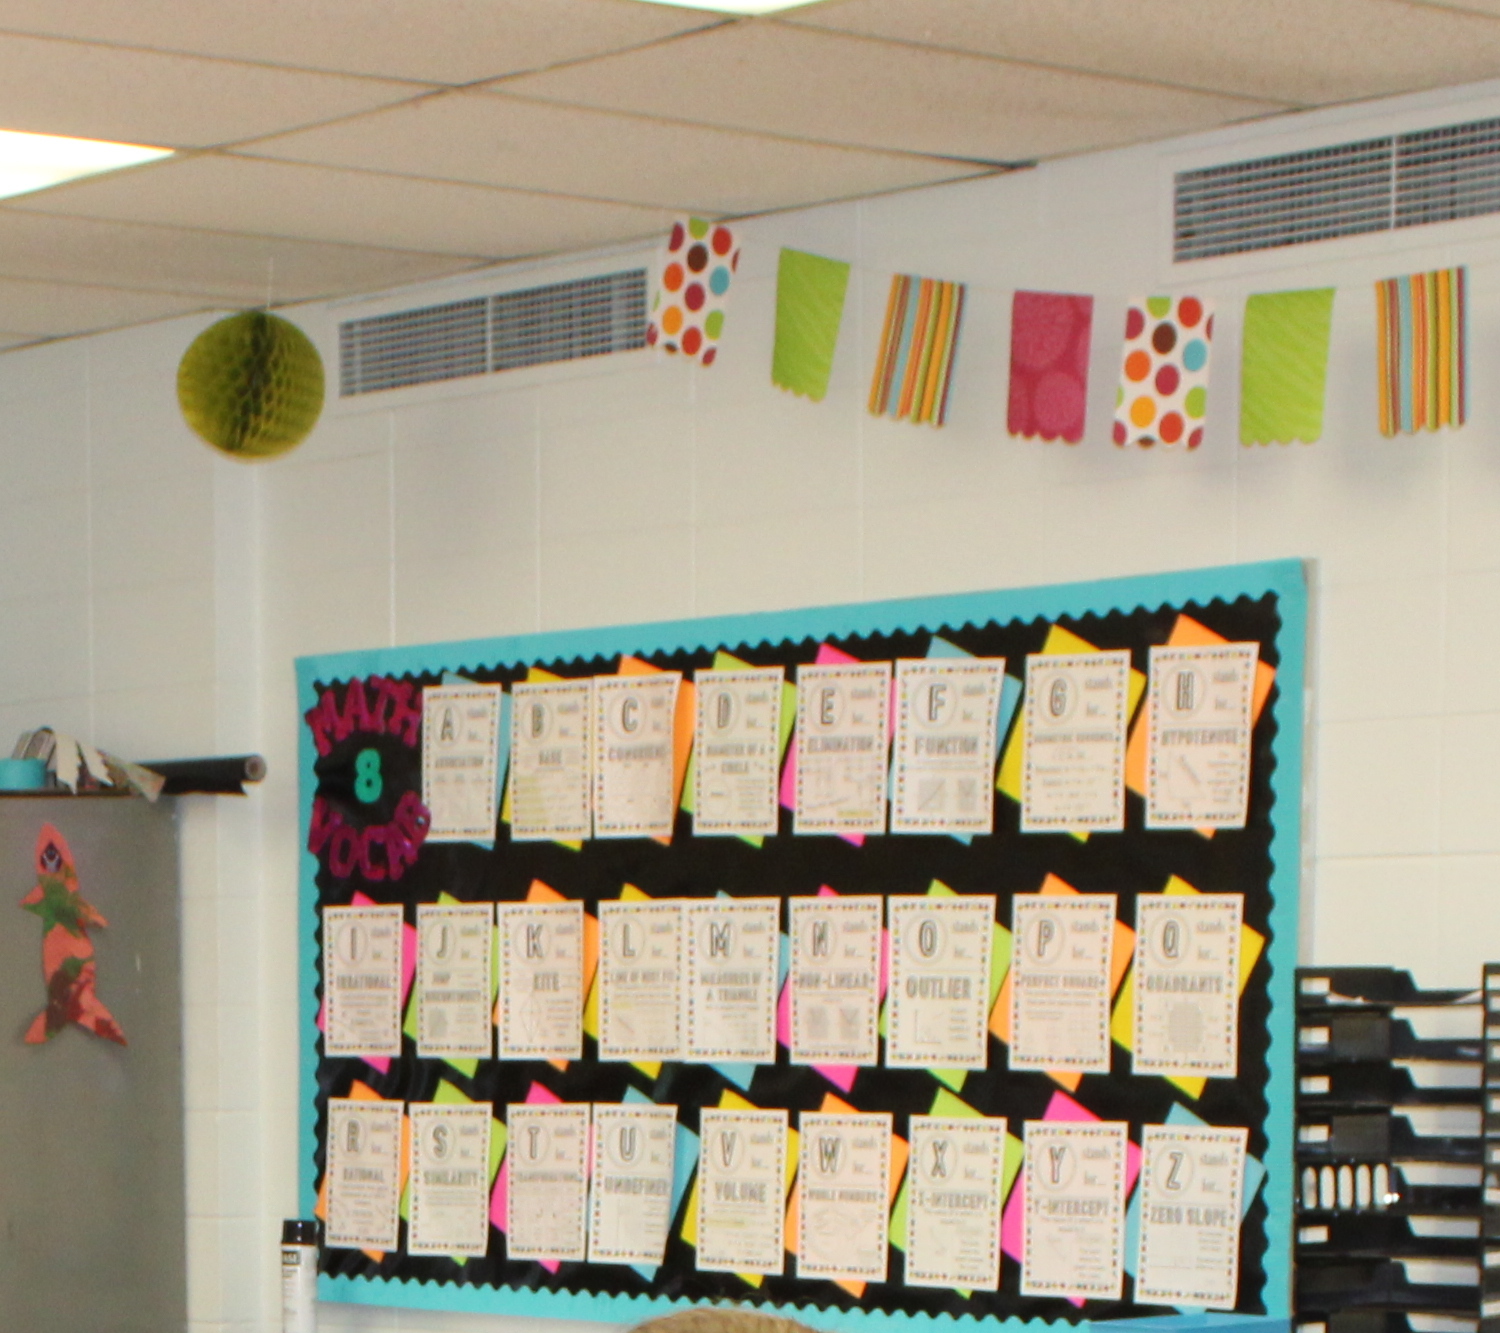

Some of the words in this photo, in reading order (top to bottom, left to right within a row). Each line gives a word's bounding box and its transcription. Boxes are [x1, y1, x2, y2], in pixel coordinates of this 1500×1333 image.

[821, 689, 834, 725] E
[929, 684, 947, 721] F
[1050, 678, 1067, 717] G
[1176, 672, 1194, 711] H
[305, 675, 422, 756] MATH
[440, 707, 455, 742] A
[621, 697, 638, 732] C
[716, 692, 731, 728] D
[354, 748, 382, 803] 8
[350, 927, 356, 961] I
[436, 926, 449, 960] J
[527, 924, 543, 959] K
[623, 924, 636, 957] L
[710, 922, 730, 958] M
[814, 920, 828, 956] N
[918, 920, 938, 957] O
[1038, 920, 1055, 957] P
[1164, 920, 1180, 957] Q
[906, 975, 972, 1000] OUTLIER
[347, 1121, 359, 1154] R
[433, 1125, 447, 1158] S
[527, 1126, 540, 1159] T
[620, 1126, 635, 1160] U
[720, 1131, 735, 1167] V
[818, 1137, 841, 1173] W
[932, 1141, 947, 1177] X
[1050, 1146, 1065, 1184] Y
[1168, 1152, 1182, 1190] Z
[1150, 1206, 1184, 1227] ZERO
[1187, 1207, 1228, 1227] SLOPE
